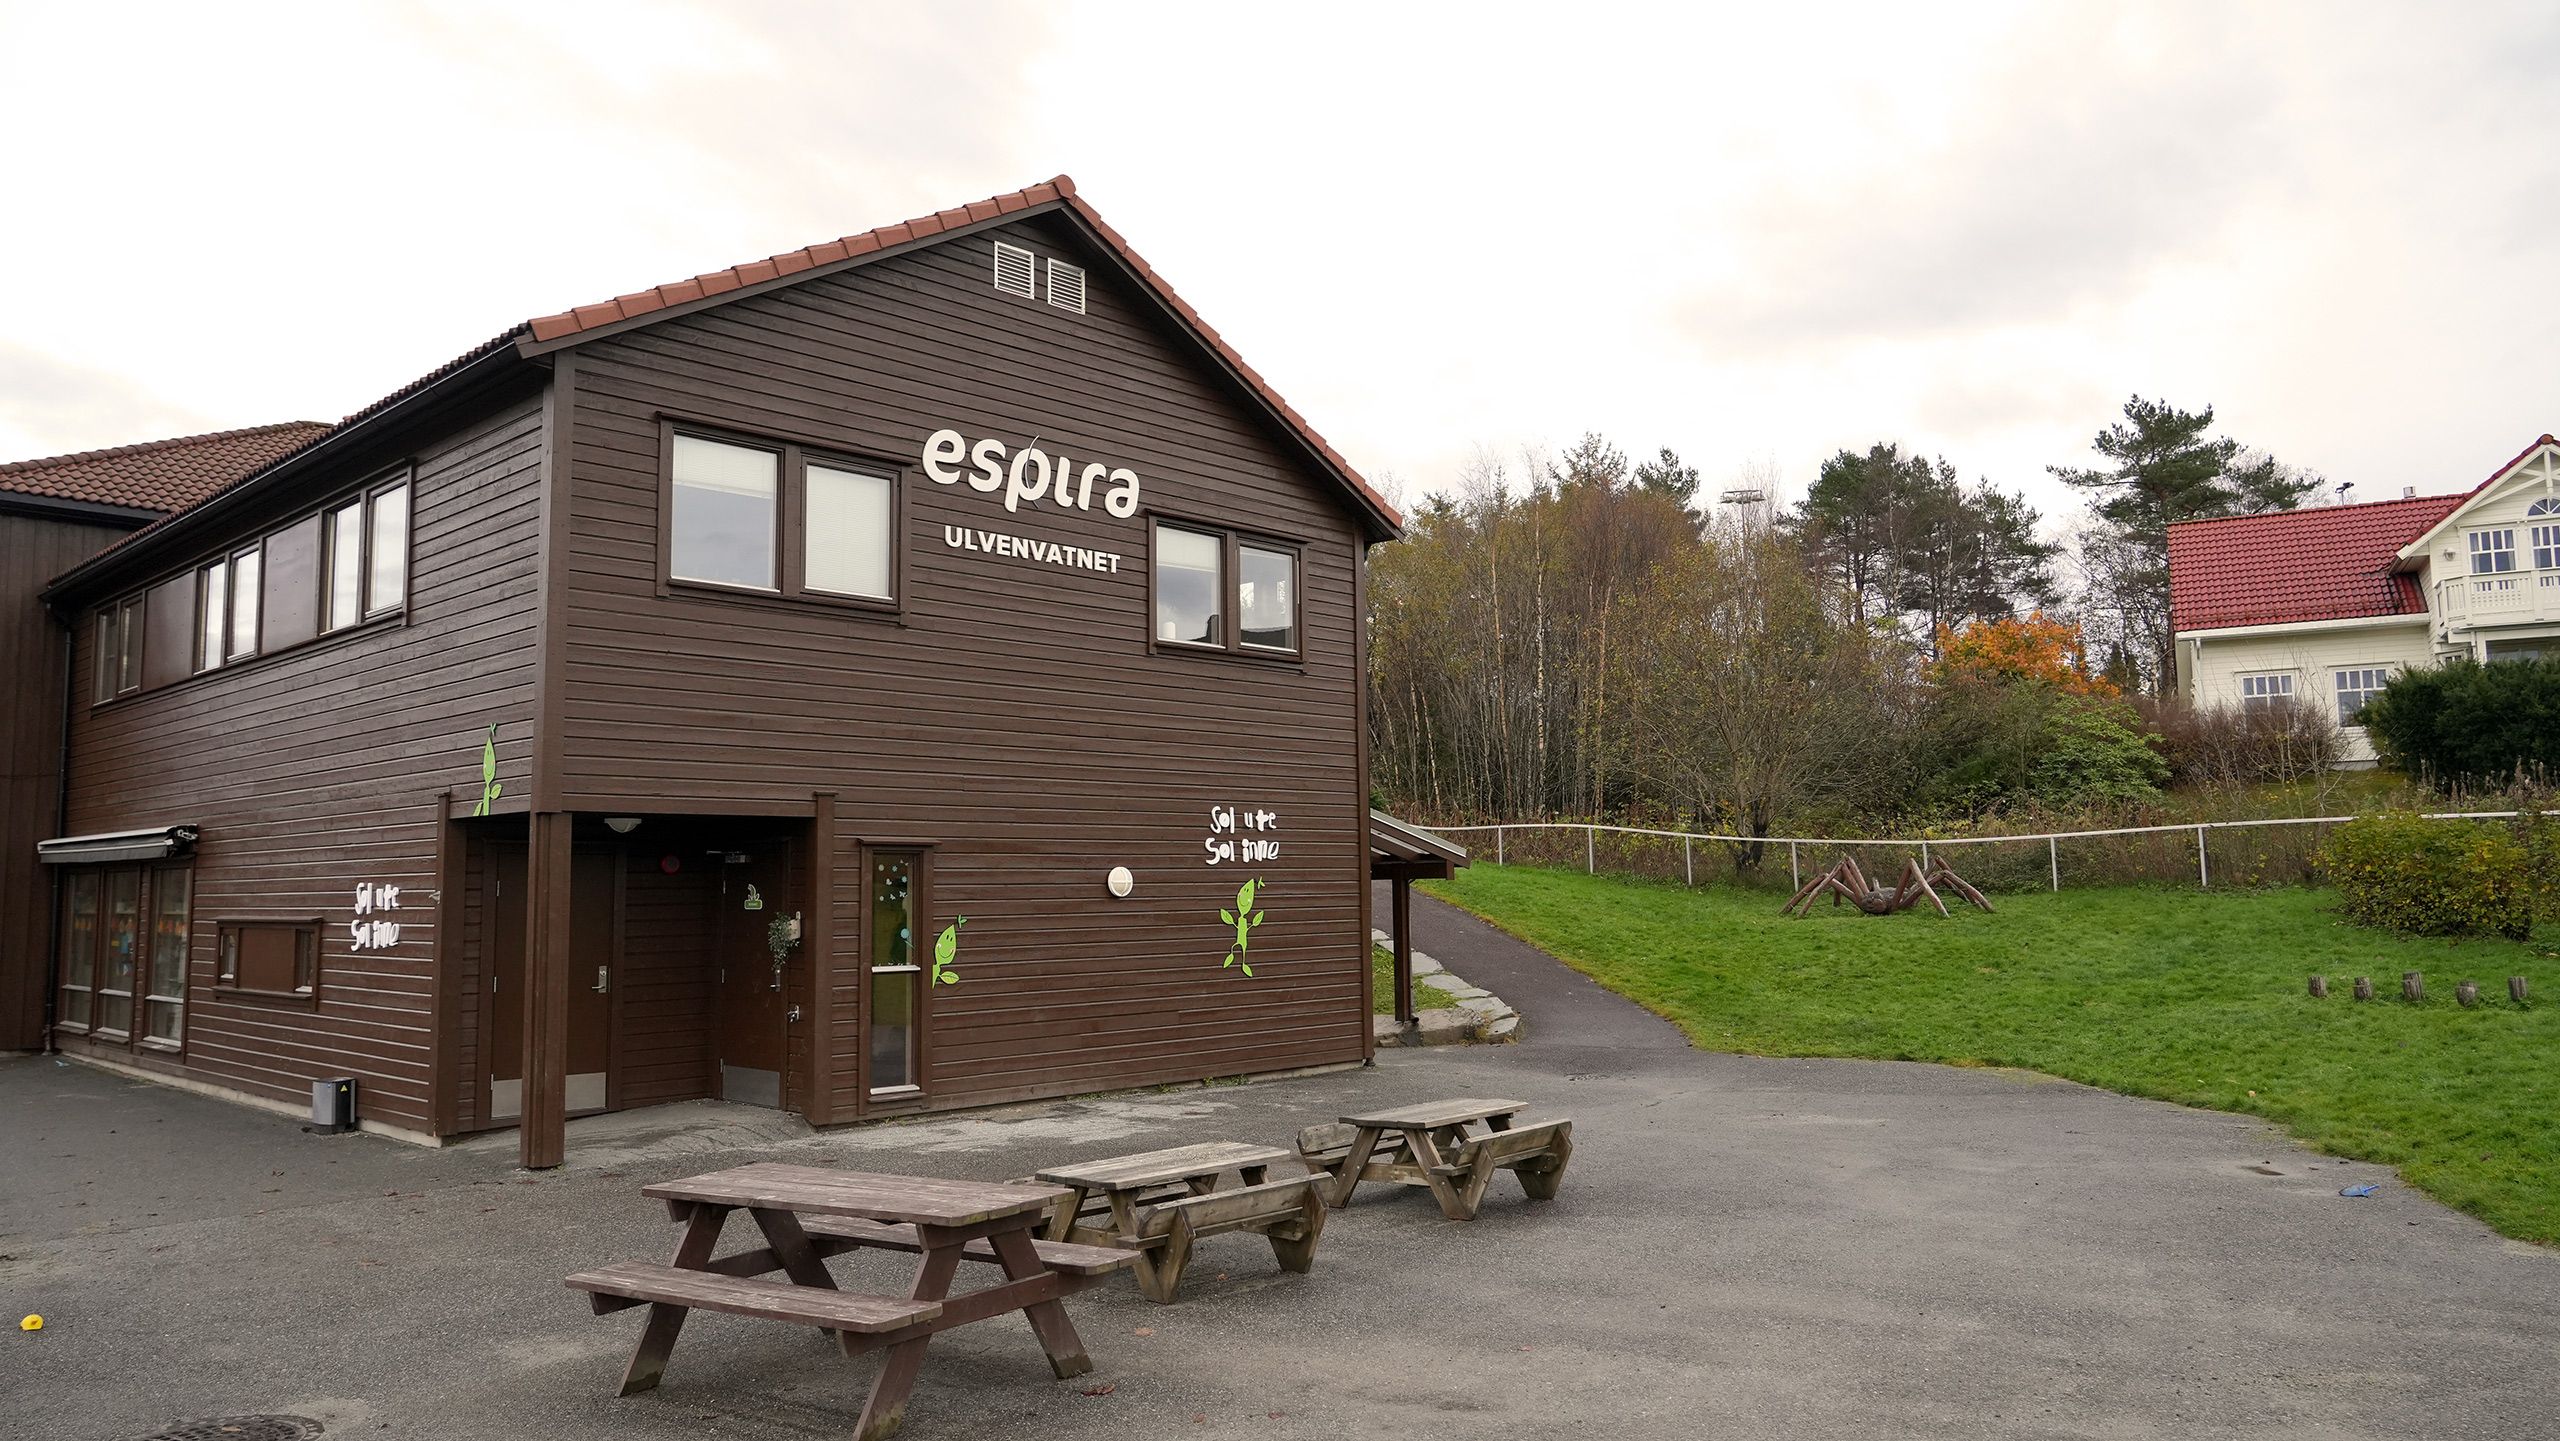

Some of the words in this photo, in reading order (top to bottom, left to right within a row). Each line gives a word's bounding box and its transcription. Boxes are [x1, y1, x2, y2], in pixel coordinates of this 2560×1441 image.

[922, 429, 1140, 519] espira
[944, 525, 1120, 574] ULVENVATNET
[1210, 806, 1235, 834] Sol
[1244, 809, 1277, 832] ute
[1205, 837, 1235, 865] Sol
[1242, 838, 1279, 863] inne
[376, 884, 400, 911] ute
